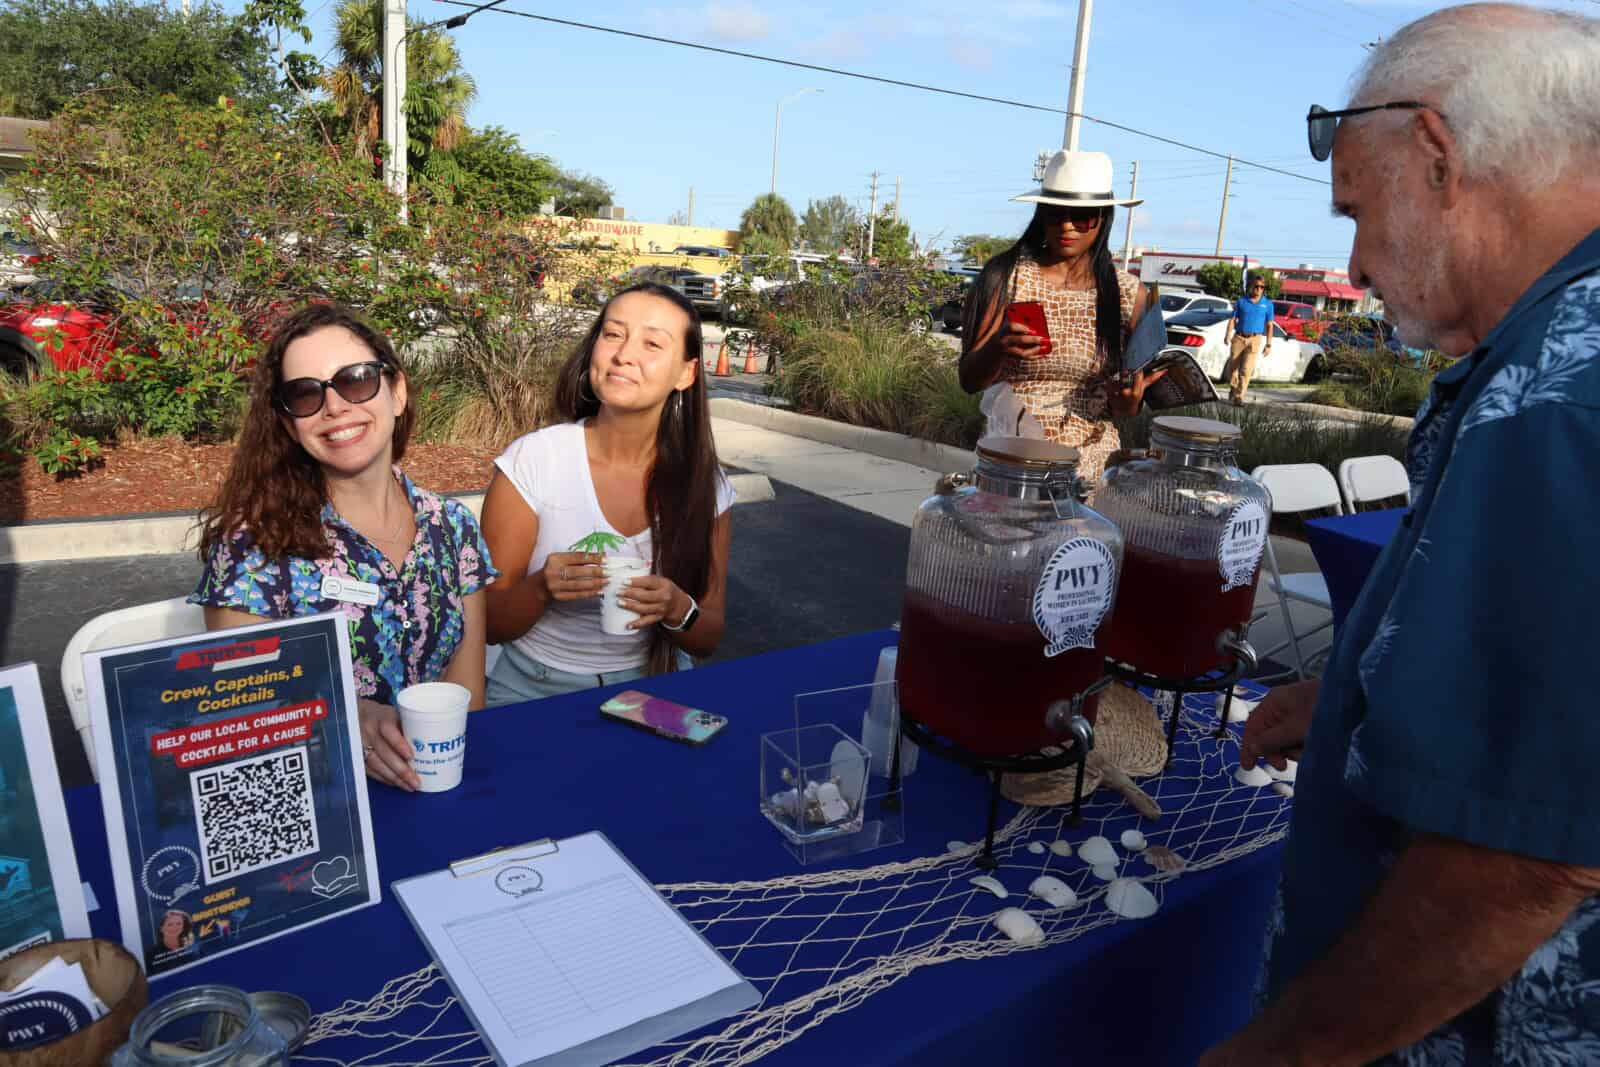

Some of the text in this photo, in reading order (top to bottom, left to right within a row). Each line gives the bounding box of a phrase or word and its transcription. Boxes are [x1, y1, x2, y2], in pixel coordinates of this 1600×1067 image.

[1231, 516, 1264, 540] PWY
[1054, 564, 1103, 590] PWY
[161, 664, 304, 704] Crew, Captains, &
[197, 687, 275, 712] Cocktails
[156, 705, 323, 751] HELP OUR LOCAL COMMUNITY &
[180, 726, 307, 763] COCKTAIL FOR A CAUSE
[8, 1021, 45, 1042] PWY
